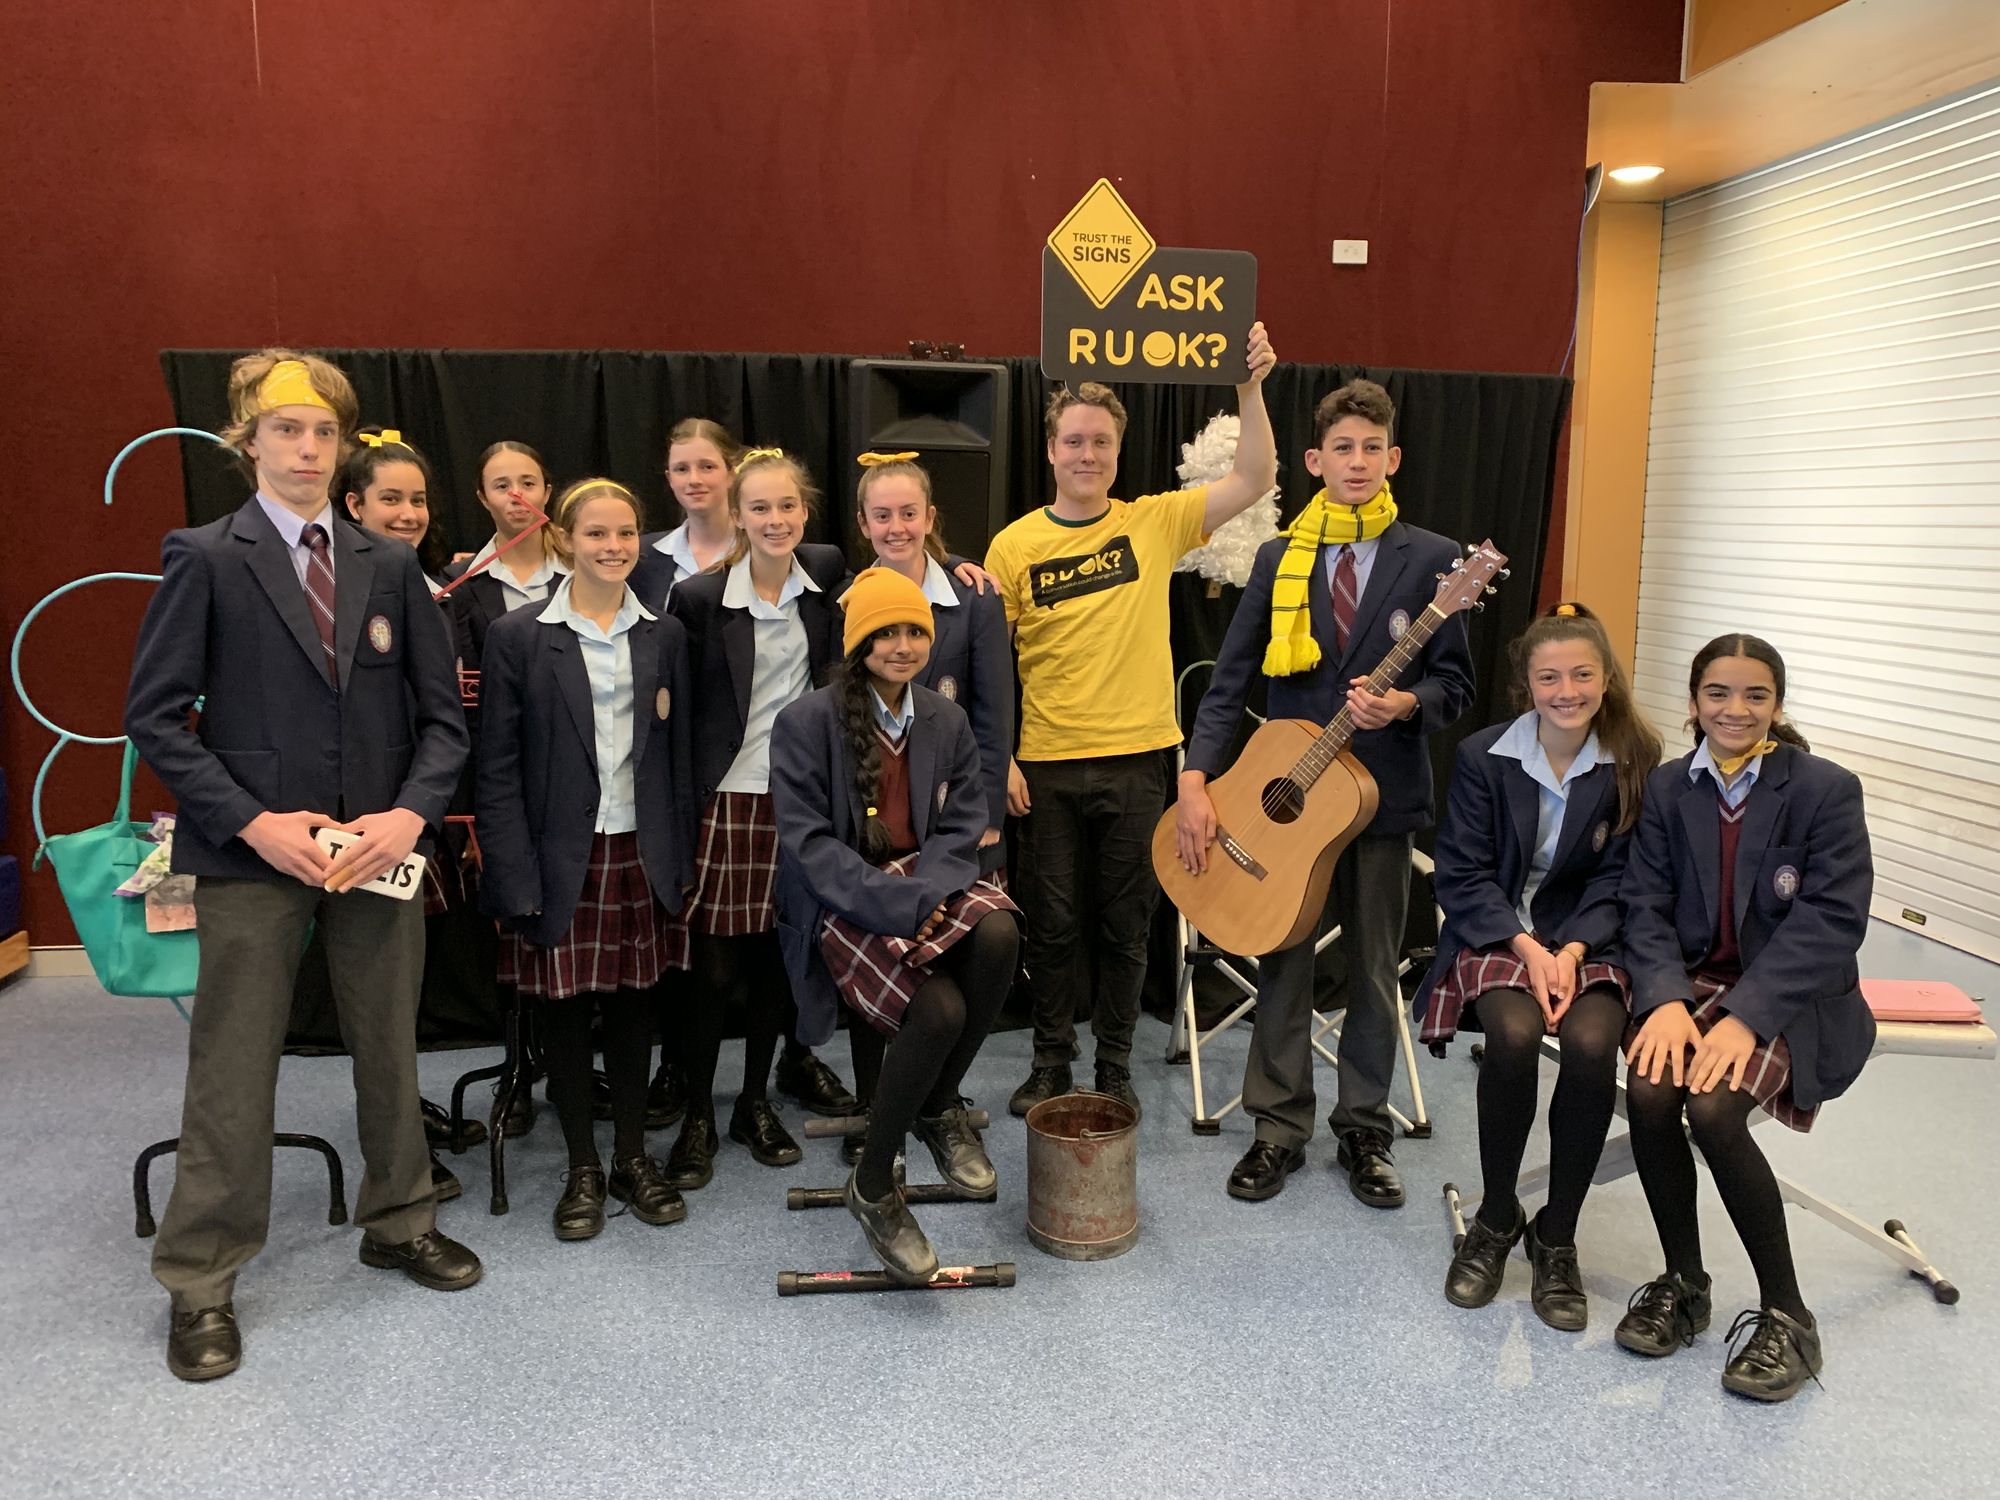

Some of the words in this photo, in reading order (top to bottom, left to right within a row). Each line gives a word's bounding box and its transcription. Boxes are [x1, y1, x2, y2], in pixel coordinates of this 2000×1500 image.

[1073, 233, 1108, 243] TRUST
[1111, 235, 1132, 244] THE
[1073, 246, 1130, 263] SIGNS
[1137, 273, 1224, 312] ASK
